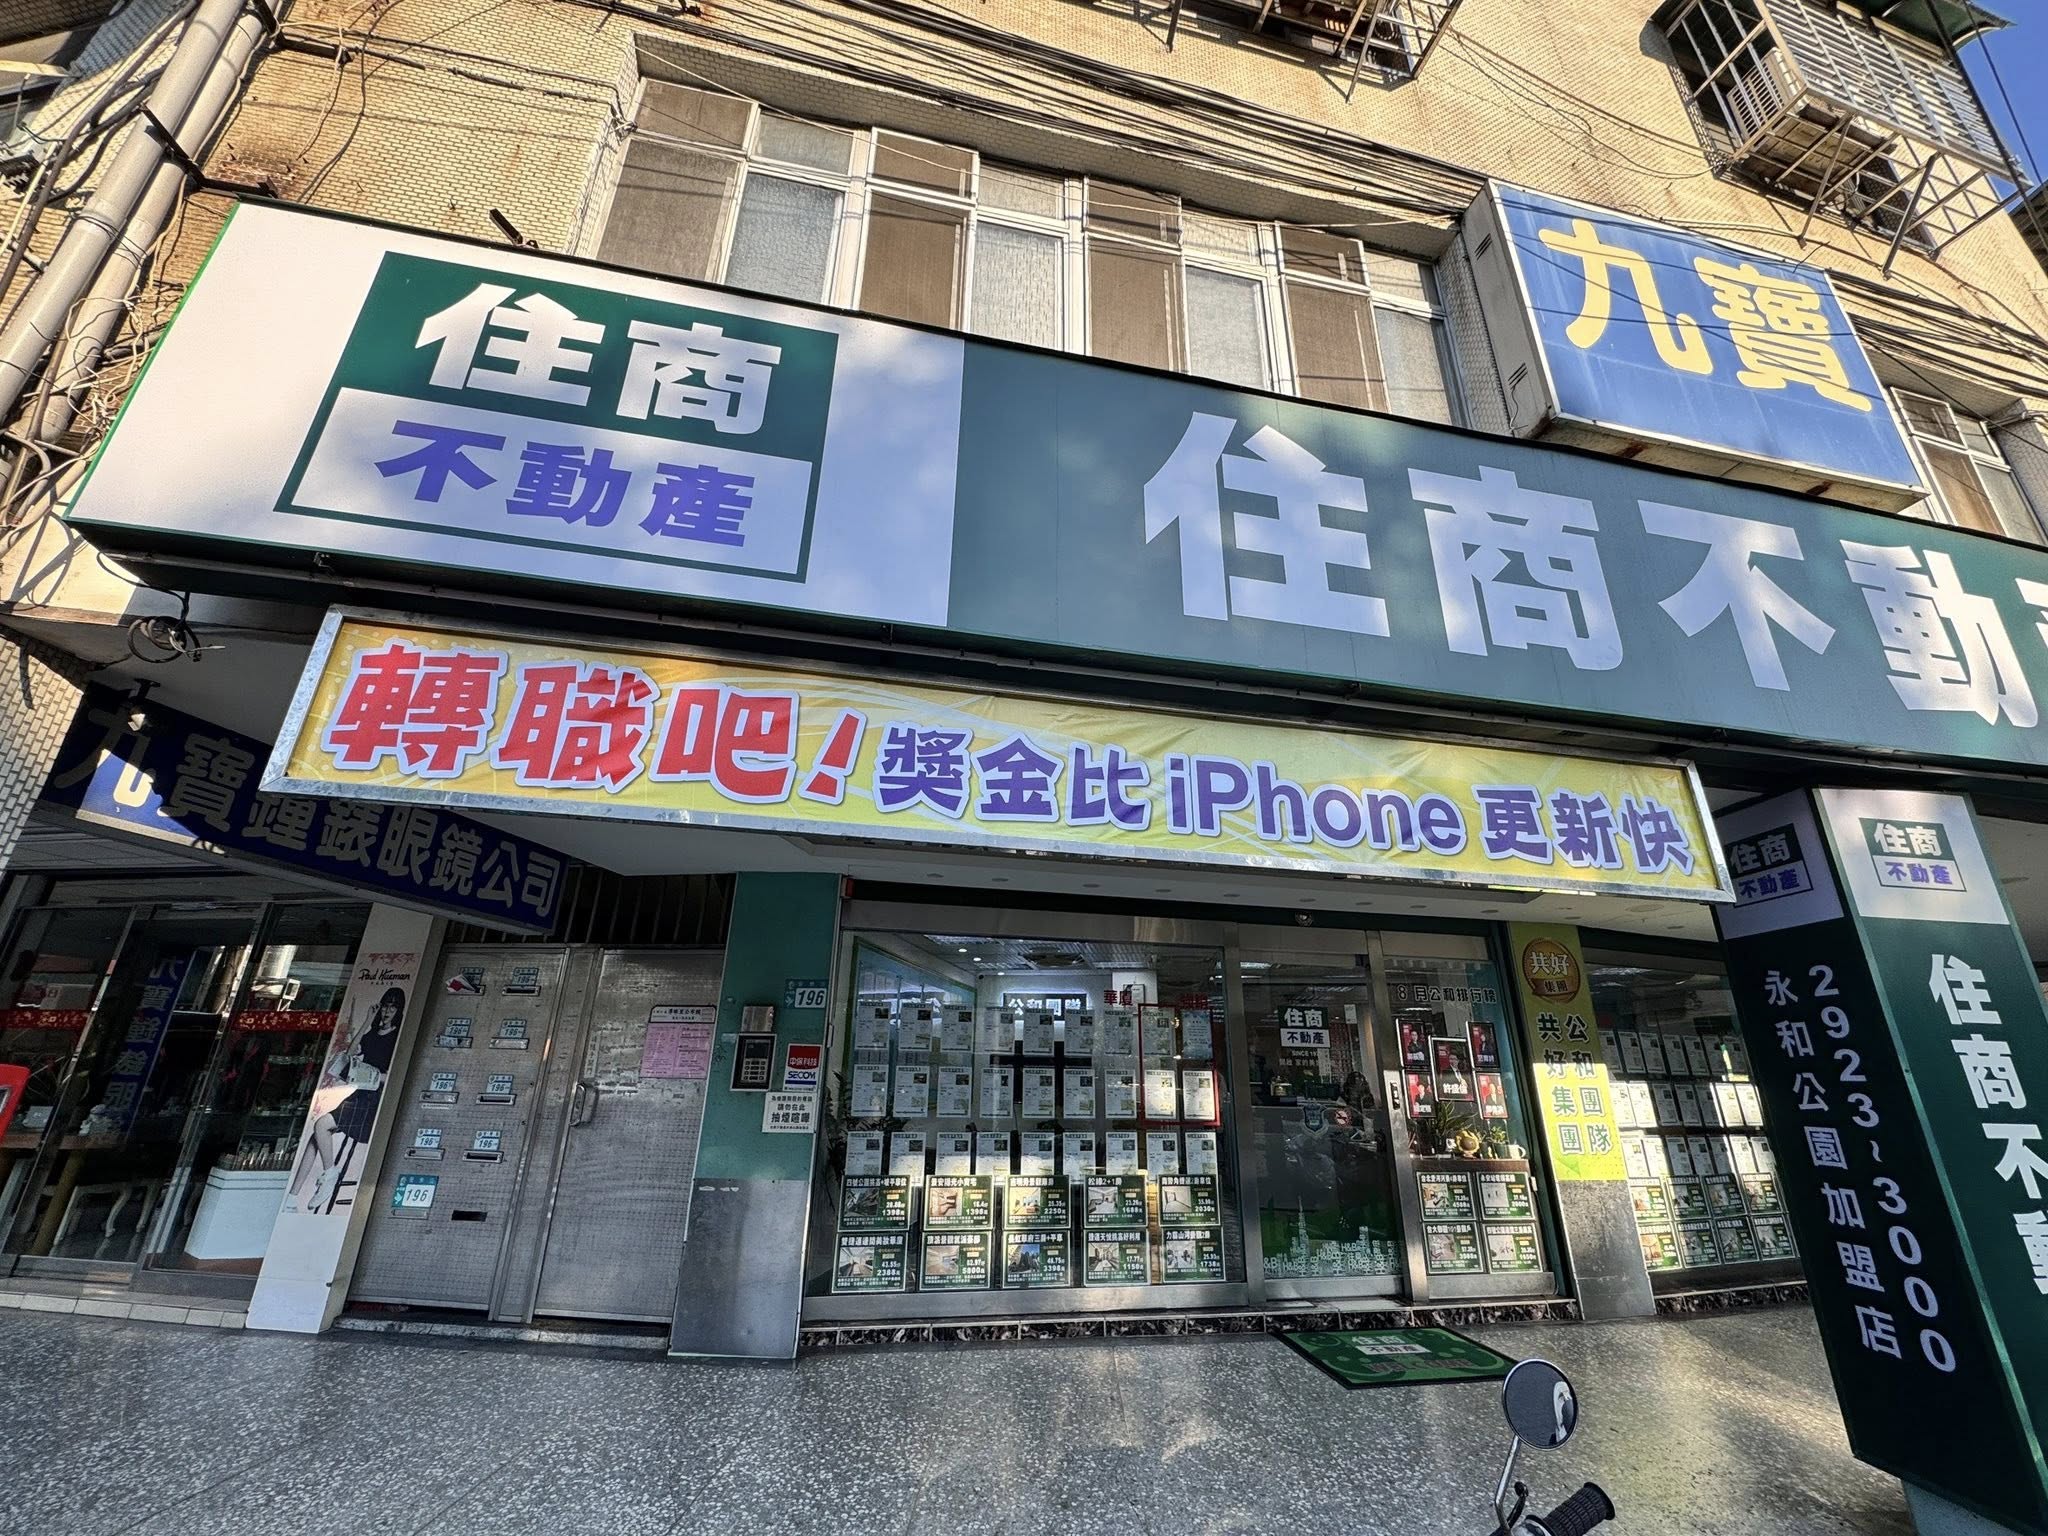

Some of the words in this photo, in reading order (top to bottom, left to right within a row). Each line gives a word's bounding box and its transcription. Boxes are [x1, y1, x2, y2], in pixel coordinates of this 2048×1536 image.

[1538, 217, 1873, 412] 九寶
[416, 281, 781, 435] 住商
[375, 419, 755, 547] 不動產
[1143, 411, 2048, 728] 住商不動
[879, 724, 1150, 824] 獎金比
[1169, 756, 1462, 851] iPhone
[1482, 785, 1691, 873] 更新快
[1730, 833, 1791, 874] 住商
[1874, 822, 1942, 856] 住商
[1738, 869, 1800, 898] 不動產
[1885, 861, 1953, 885] 不動產
[1529, 951, 1569, 976] 共好
[798, 990, 825, 1006] 196
[1543, 980, 1568, 993] 集團
[1284, 1008, 1323, 1027] 住商
[1287, 1032, 1324, 1044] 不動產
[788, 1071, 816, 1079] SECOM
[789, 1057, 817, 1066] 中保科技
[1537, 1011, 1583, 1155] 共好集團
[1565, 1013, 1612, 1153] 公和團隊
[1764, 969, 1902, 1360] 永和公園加盟店
[406, 1189, 429, 1202] 196
